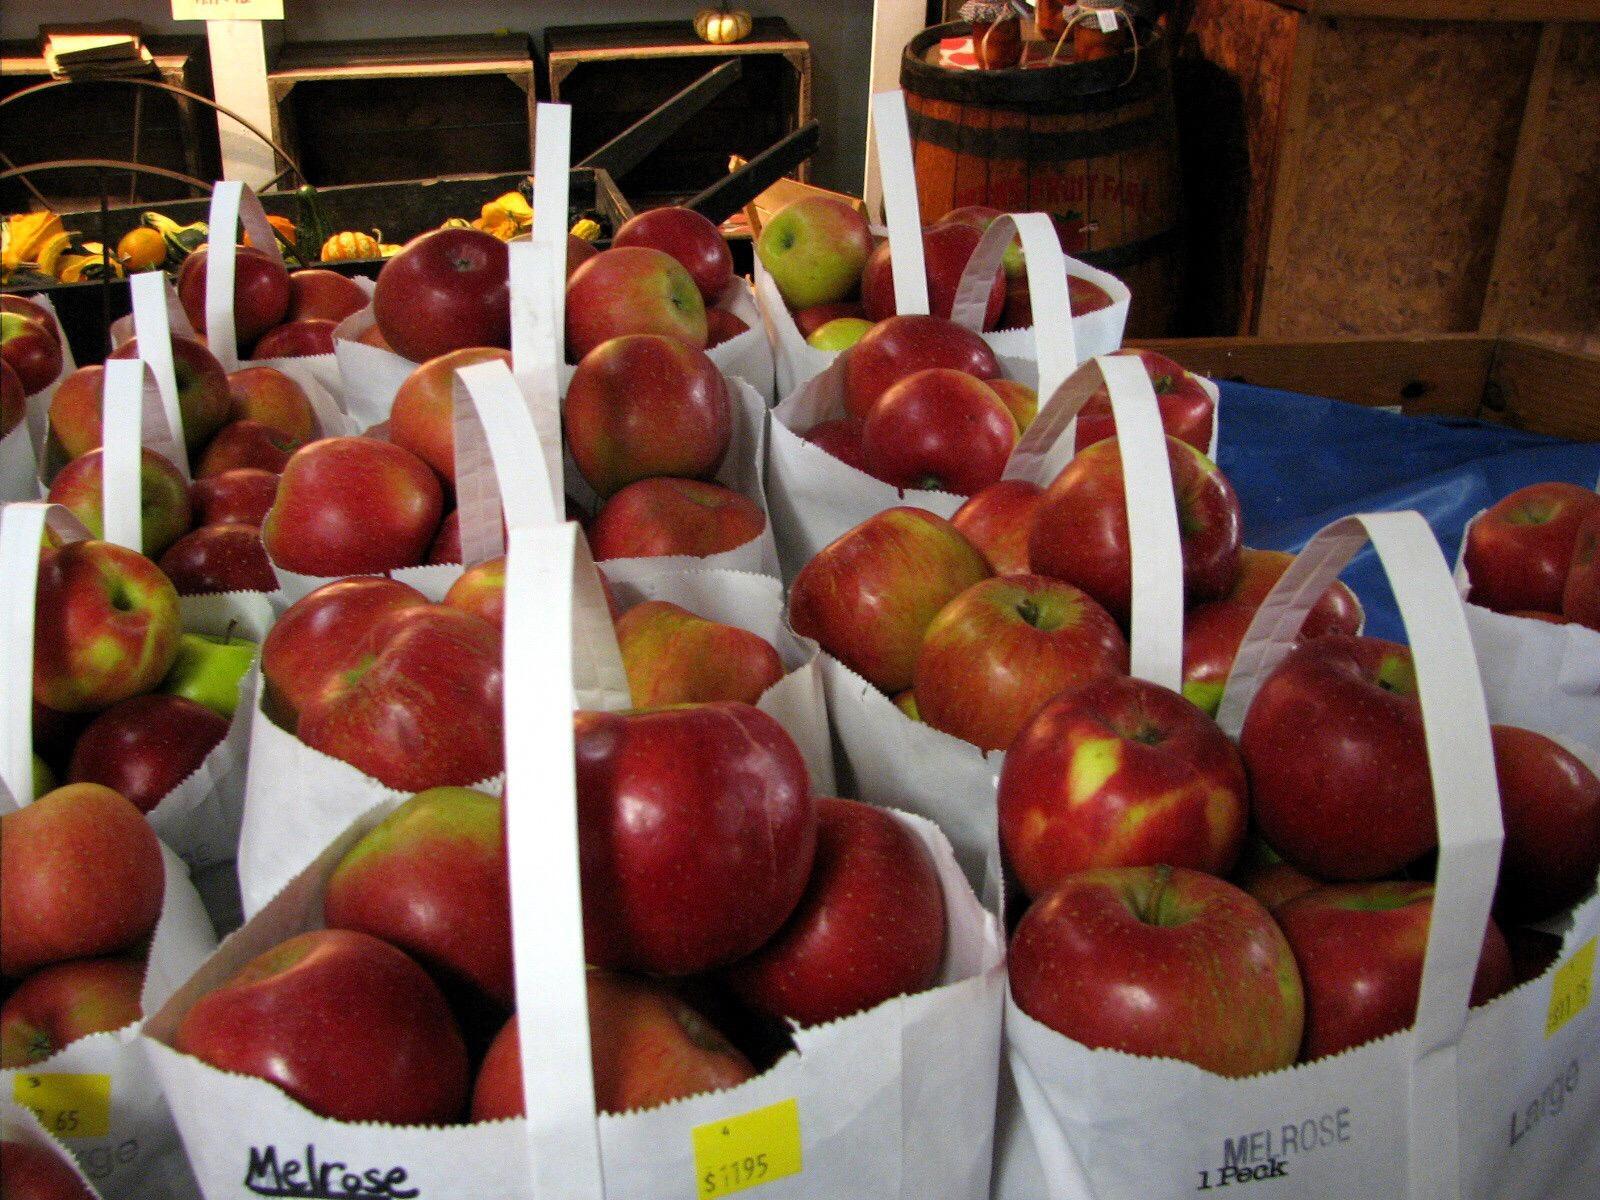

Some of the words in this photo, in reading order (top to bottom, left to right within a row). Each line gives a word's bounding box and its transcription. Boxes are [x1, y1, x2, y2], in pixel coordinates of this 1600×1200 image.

[1224, 1106, 1351, 1168] MELROSE
[244, 1143, 420, 1197] Melrose
[1216, 1157, 1289, 1187] Peck
